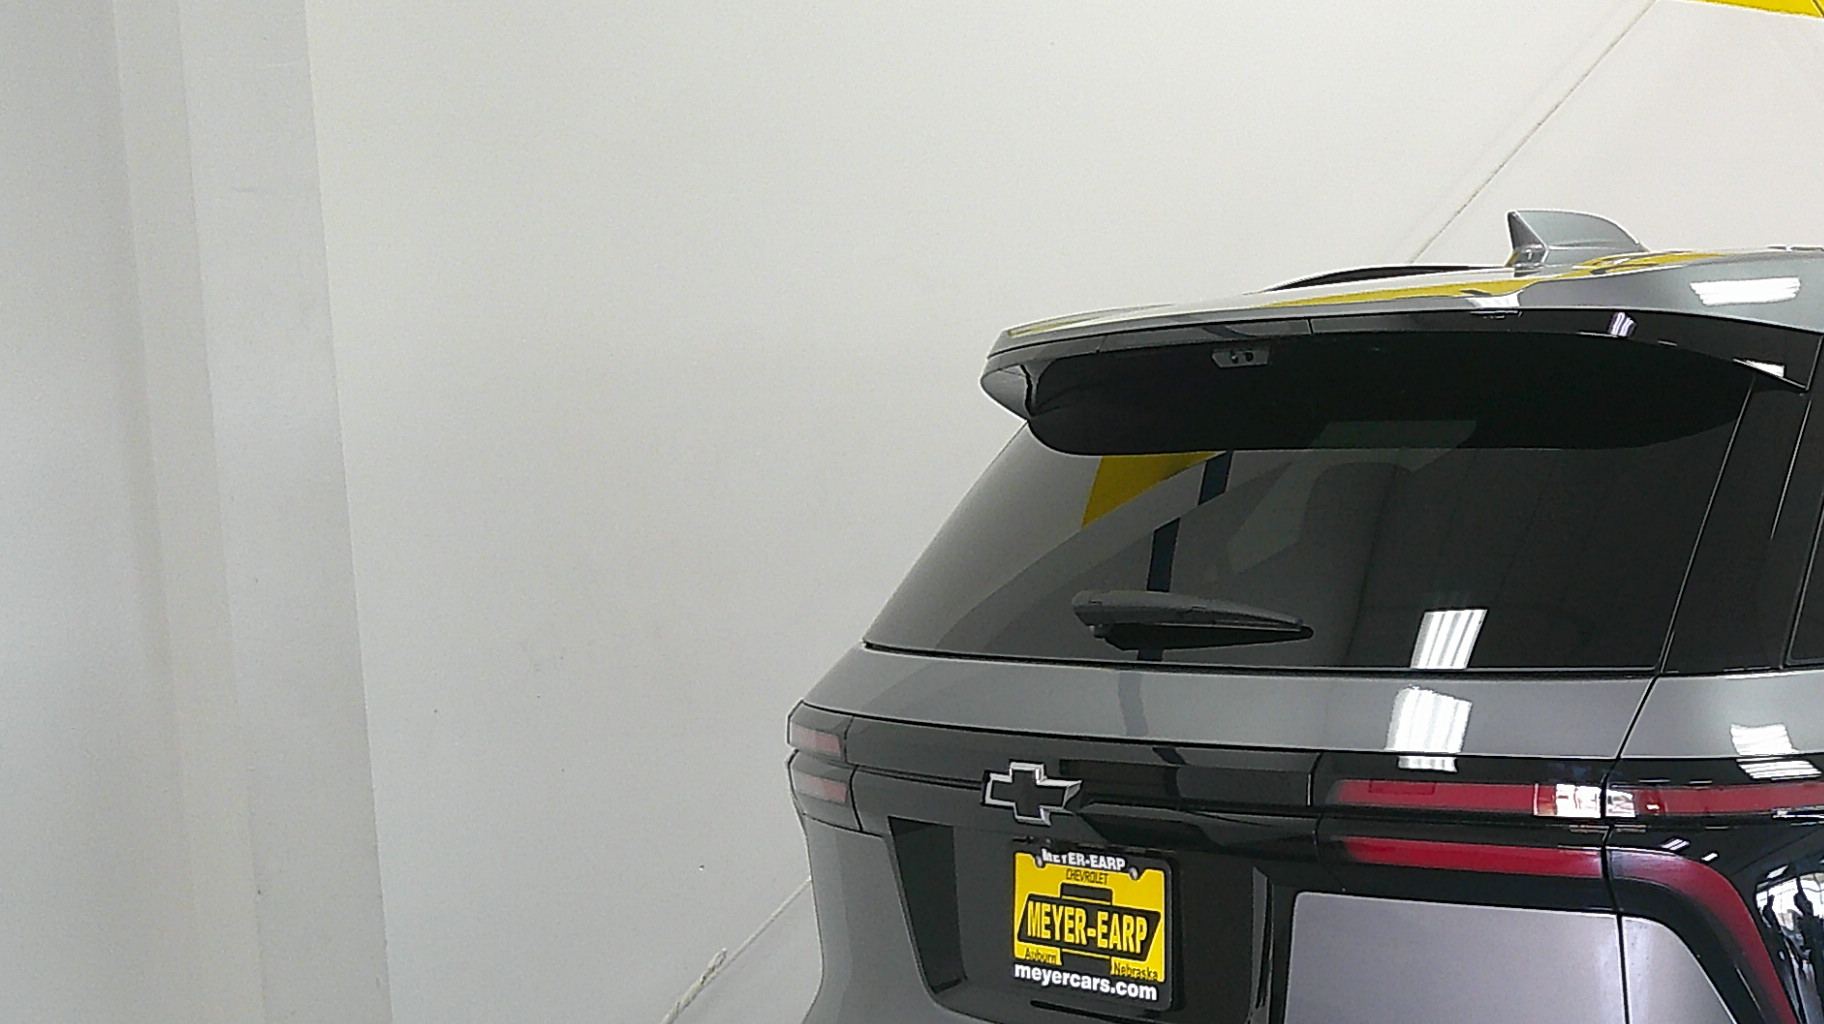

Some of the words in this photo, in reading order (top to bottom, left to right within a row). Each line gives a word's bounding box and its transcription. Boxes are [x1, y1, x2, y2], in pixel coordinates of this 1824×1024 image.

[1041, 848, 1126, 871] MEYER-EARP
[1065, 868, 1109, 885] CHEVROLET
[1026, 900, 1148, 954] MEYER-EARP
[1024, 947, 1057, 965] Auburn
[1014, 963, 1158, 1001] meyercars.com
[1113, 962, 1158, 981] Nebraska
